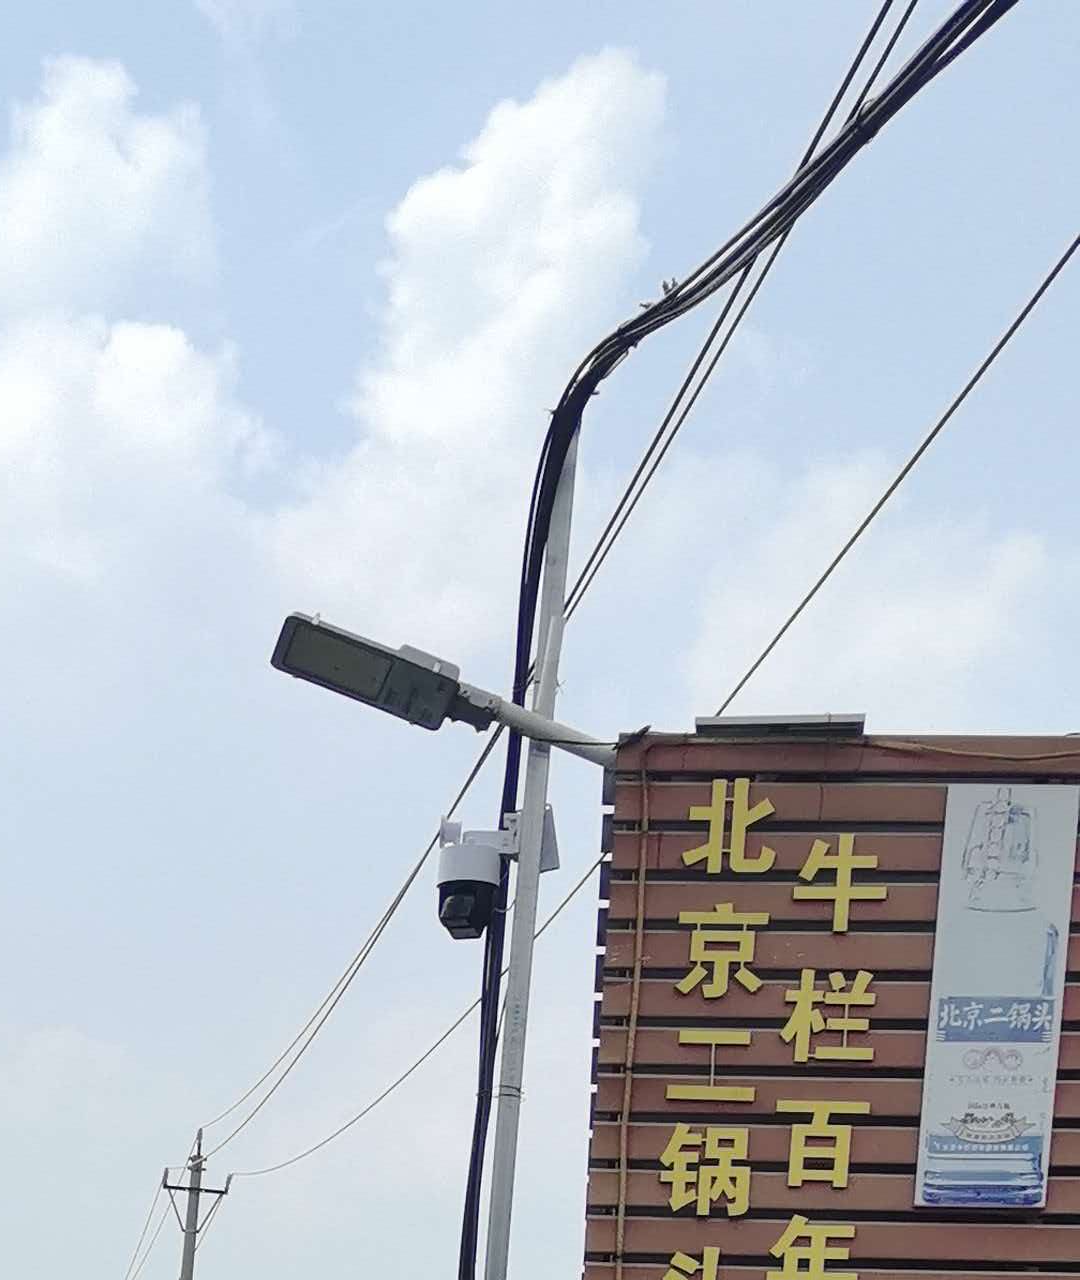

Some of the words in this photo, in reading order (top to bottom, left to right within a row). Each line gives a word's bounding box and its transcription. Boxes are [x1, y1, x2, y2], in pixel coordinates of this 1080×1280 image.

[939, 1001, 1052, 1032] 北京二锅头
